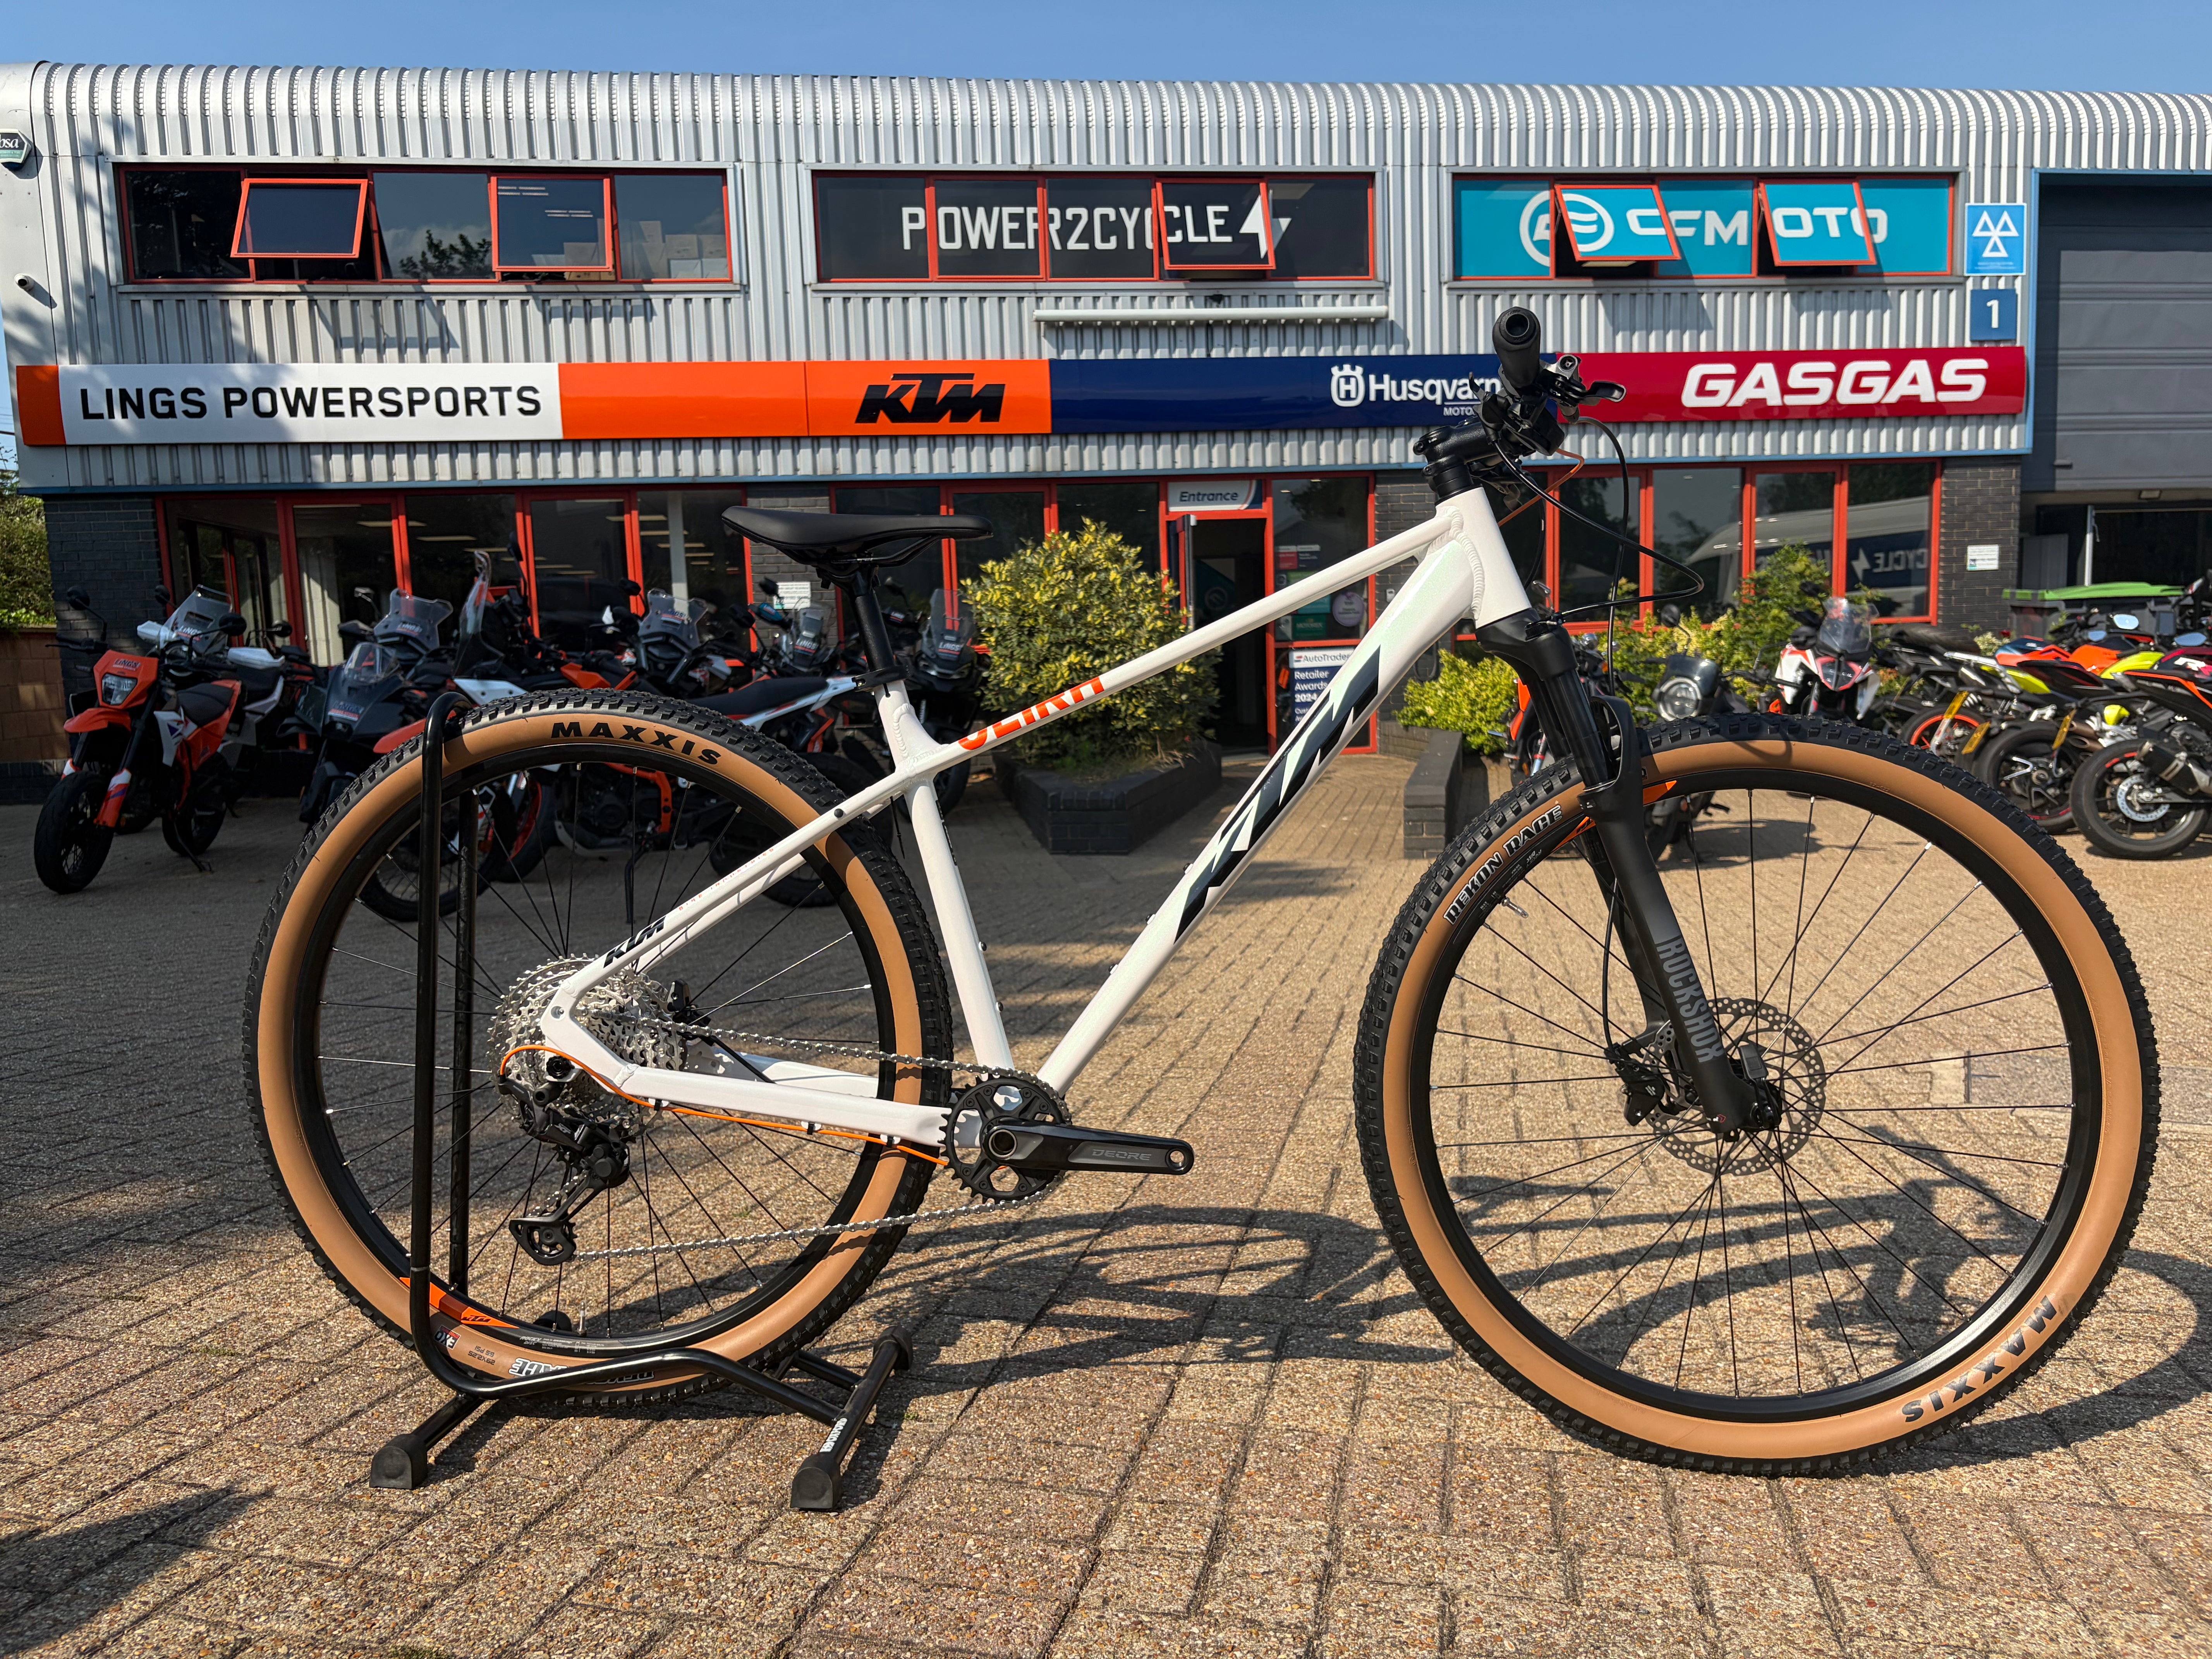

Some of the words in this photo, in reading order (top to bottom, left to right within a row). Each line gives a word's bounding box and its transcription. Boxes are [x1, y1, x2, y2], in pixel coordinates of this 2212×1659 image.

[902, 206, 1233, 250] POWER2CYCLE
[1986, 299, 1999, 329] 1
[854, 373, 1006, 424] KTM
[1369, 373, 1501, 405] Husqvarn
[1681, 358, 1989, 407] GASGAS
[80, 387, 208, 420] LINGS
[223, 386, 542, 419] POWERSPORTS
[1179, 491, 1238, 502] Entrance
[1294, 670, 1329, 680] Retailer
[1295, 681, 1328, 691] Awards
[1295, 693, 1317, 702] 2024
[551, 721, 721, 765] MAXXIS
[1443, 851, 1504, 925] REKON
[1503, 805, 1562, 857] RACE
[603, 915, 666, 969] KTM
[1656, 936, 1725, 1063] ROCKSHOX
[1092, 1149, 1152, 1161] DEORE
[434, 1331, 455, 1348] EXO
[474, 1345, 485, 1353] PSI
[1901, 1295, 2057, 1422] MAXXIS
